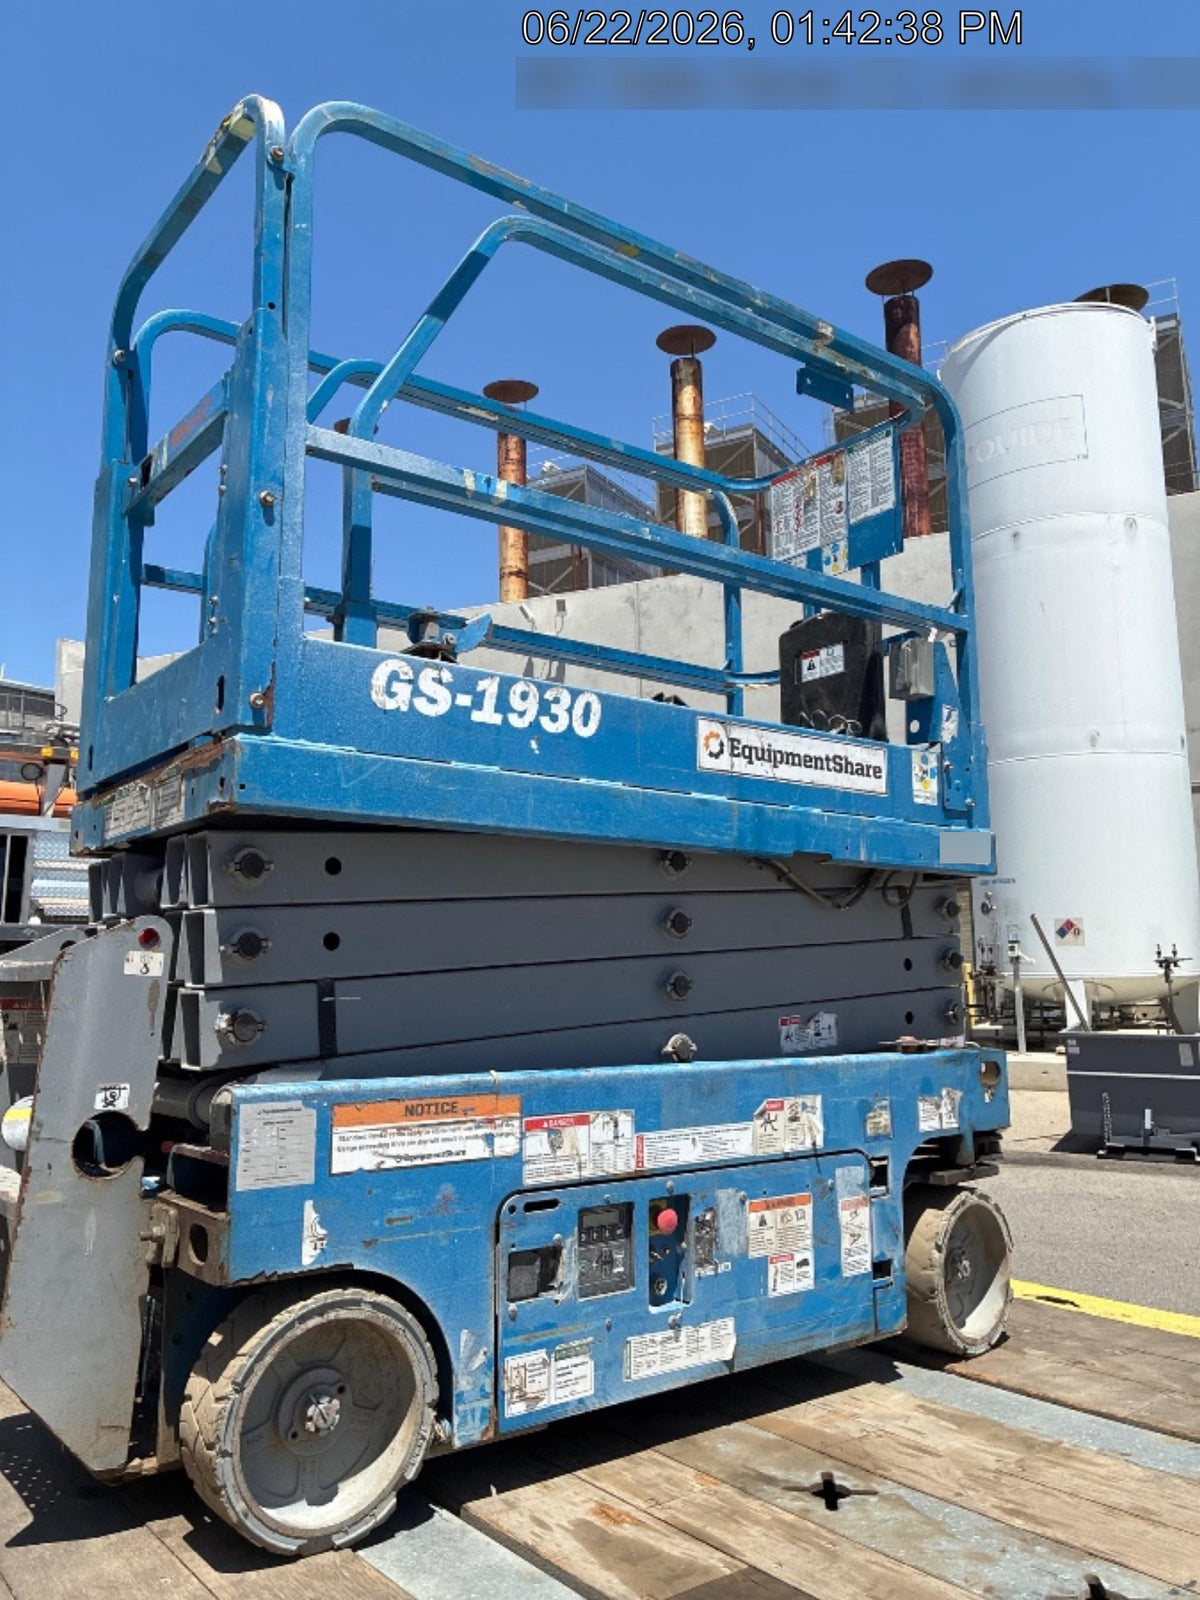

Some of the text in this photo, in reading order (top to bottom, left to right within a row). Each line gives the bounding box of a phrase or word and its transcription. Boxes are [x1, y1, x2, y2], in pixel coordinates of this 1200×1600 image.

[370, 658, 602, 737] GS-1930
[728, 737, 882, 779] EquipmentShare
[404, 1101, 458, 1117] NOTICE
